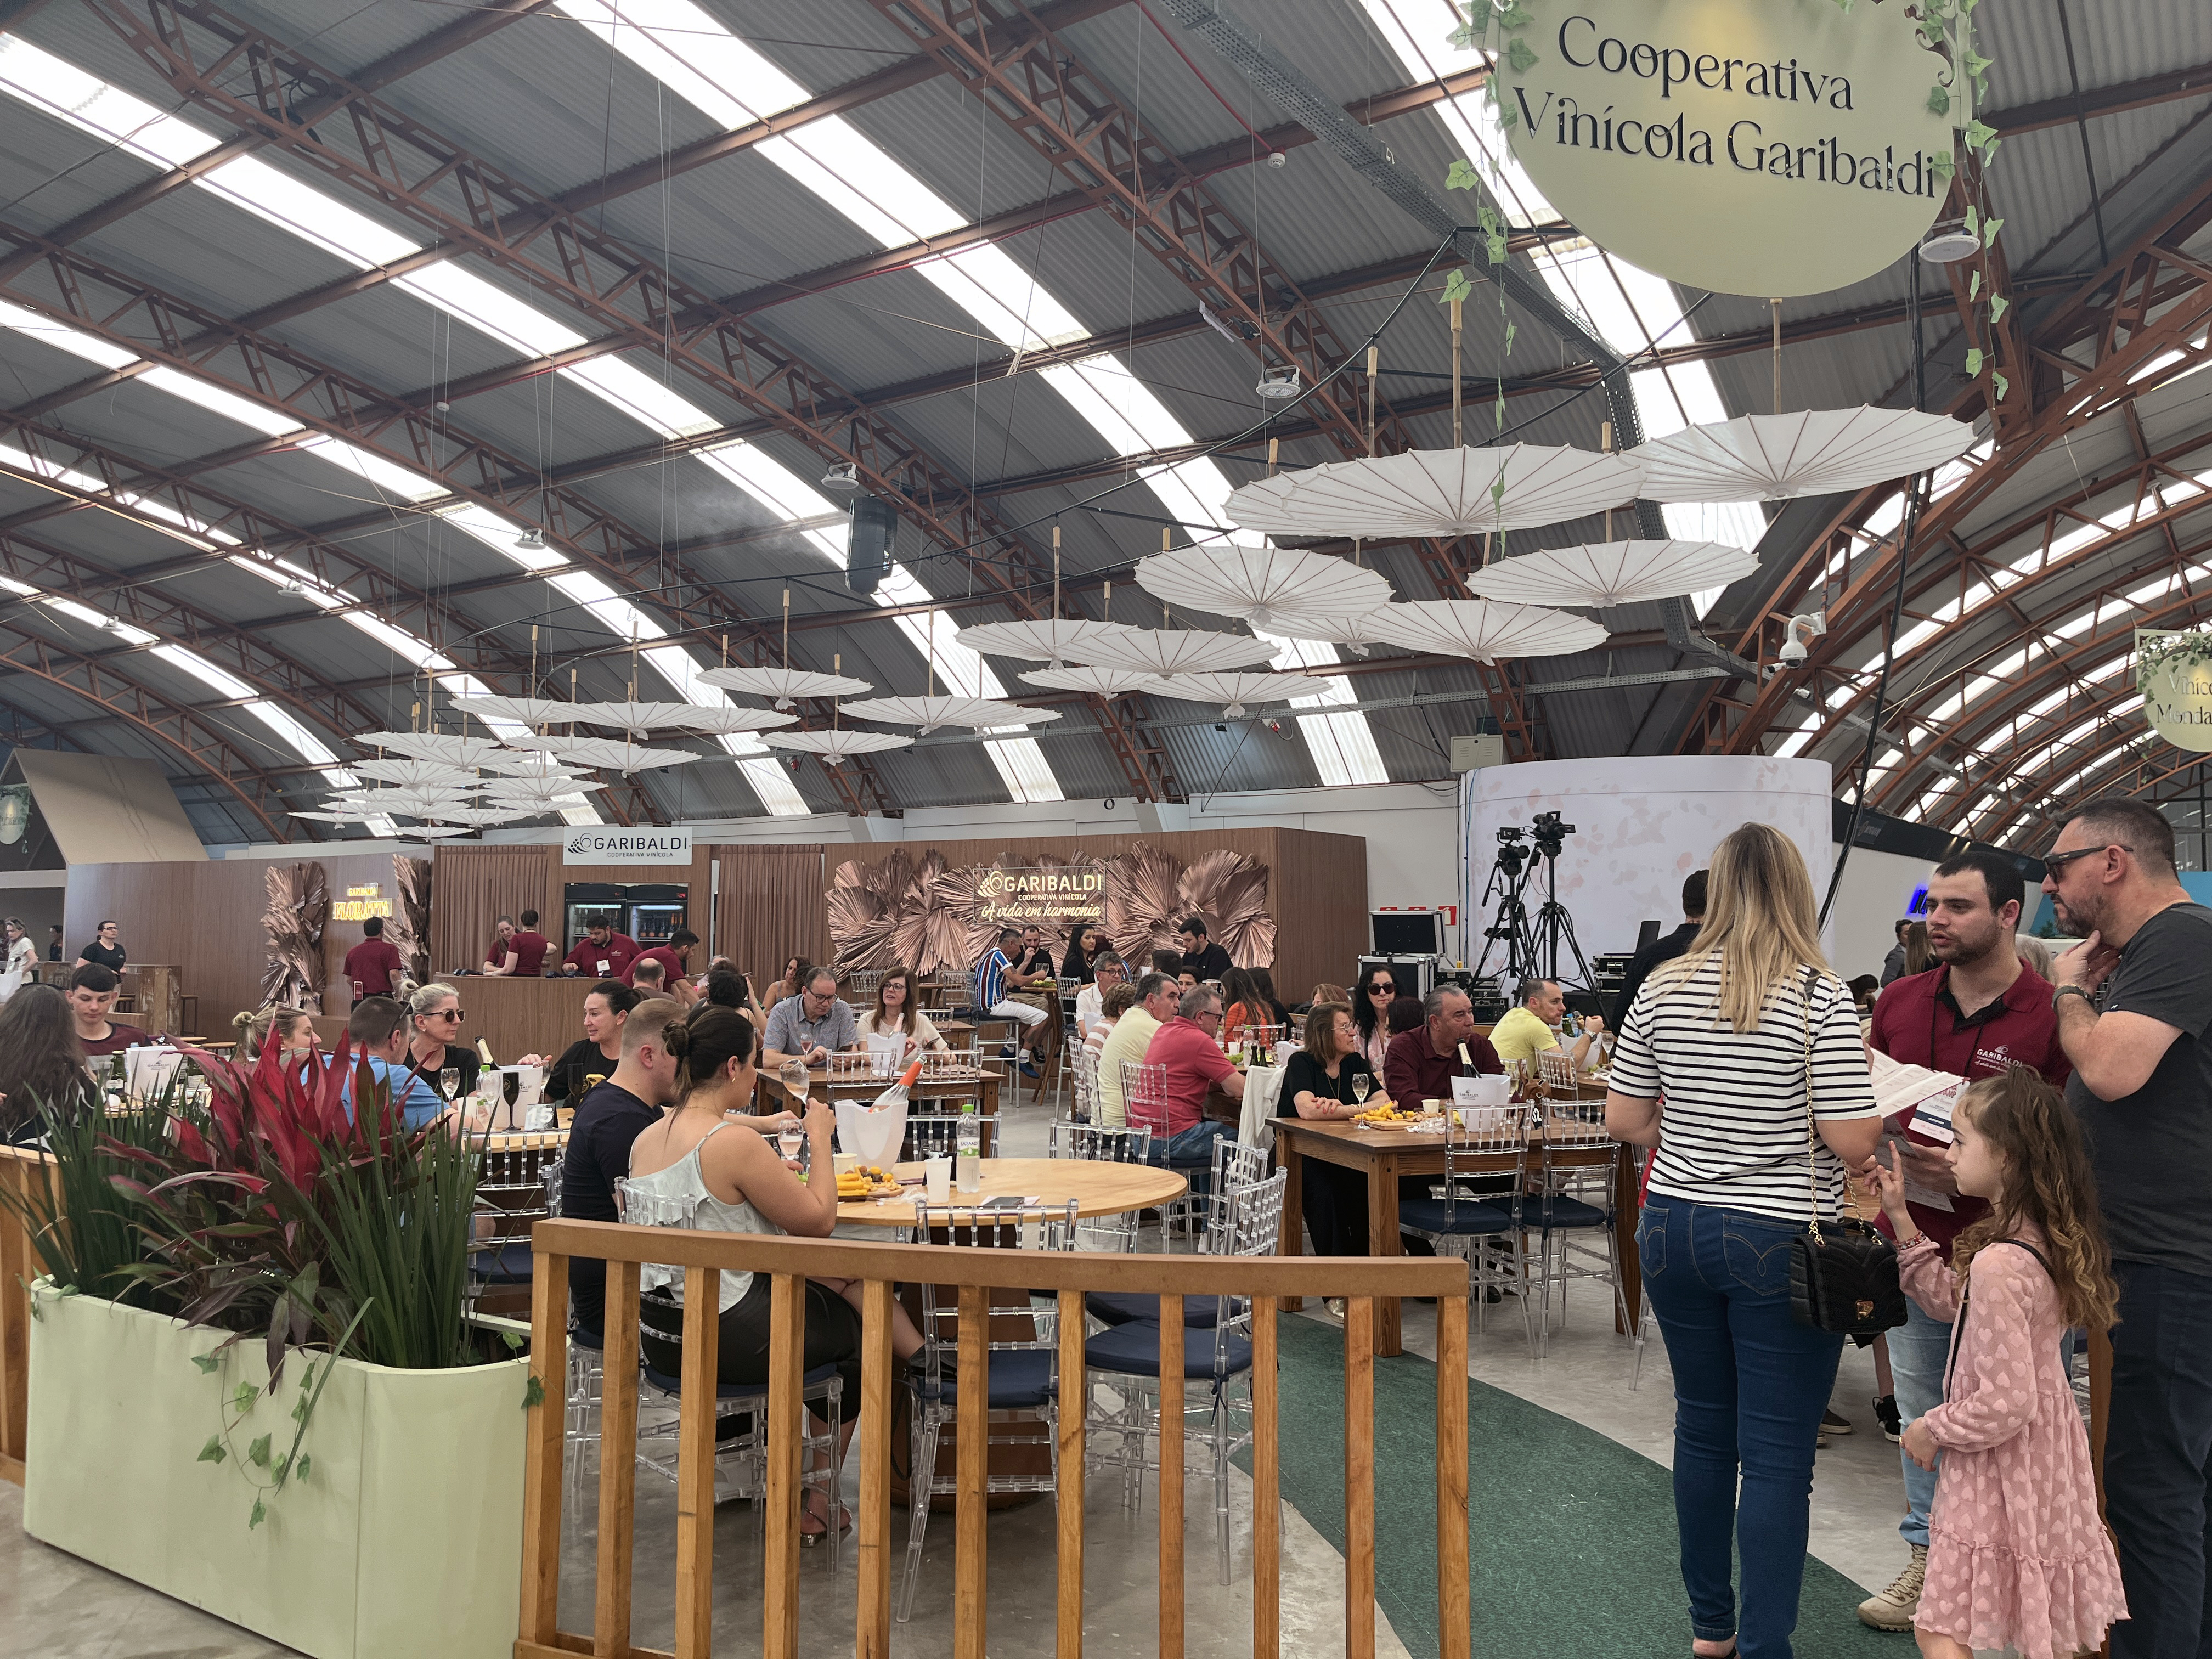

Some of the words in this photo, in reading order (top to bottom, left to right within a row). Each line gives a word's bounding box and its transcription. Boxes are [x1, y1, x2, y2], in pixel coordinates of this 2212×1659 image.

[1558, 15, 1854, 110] Cooperativa
[1512, 86, 1715, 166] Vinícola
[1727, 120, 1936, 199] Garibaldi
[594, 837, 687, 850] GARIBALDI
[348, 887, 376, 897] GARIBALDI
[1004, 874, 1102, 892] GARIBALDI
[1058, 892, 1087, 900] VINÍCOLA
[332, 901, 390, 921] FLORATTA
[981, 900, 995, 922] A
[997, 901, 1024, 918] vida
[1025, 905, 1042, 918] em
[1043, 901, 1102, 917] harmonia
[527, 1108, 553, 1124] 15
